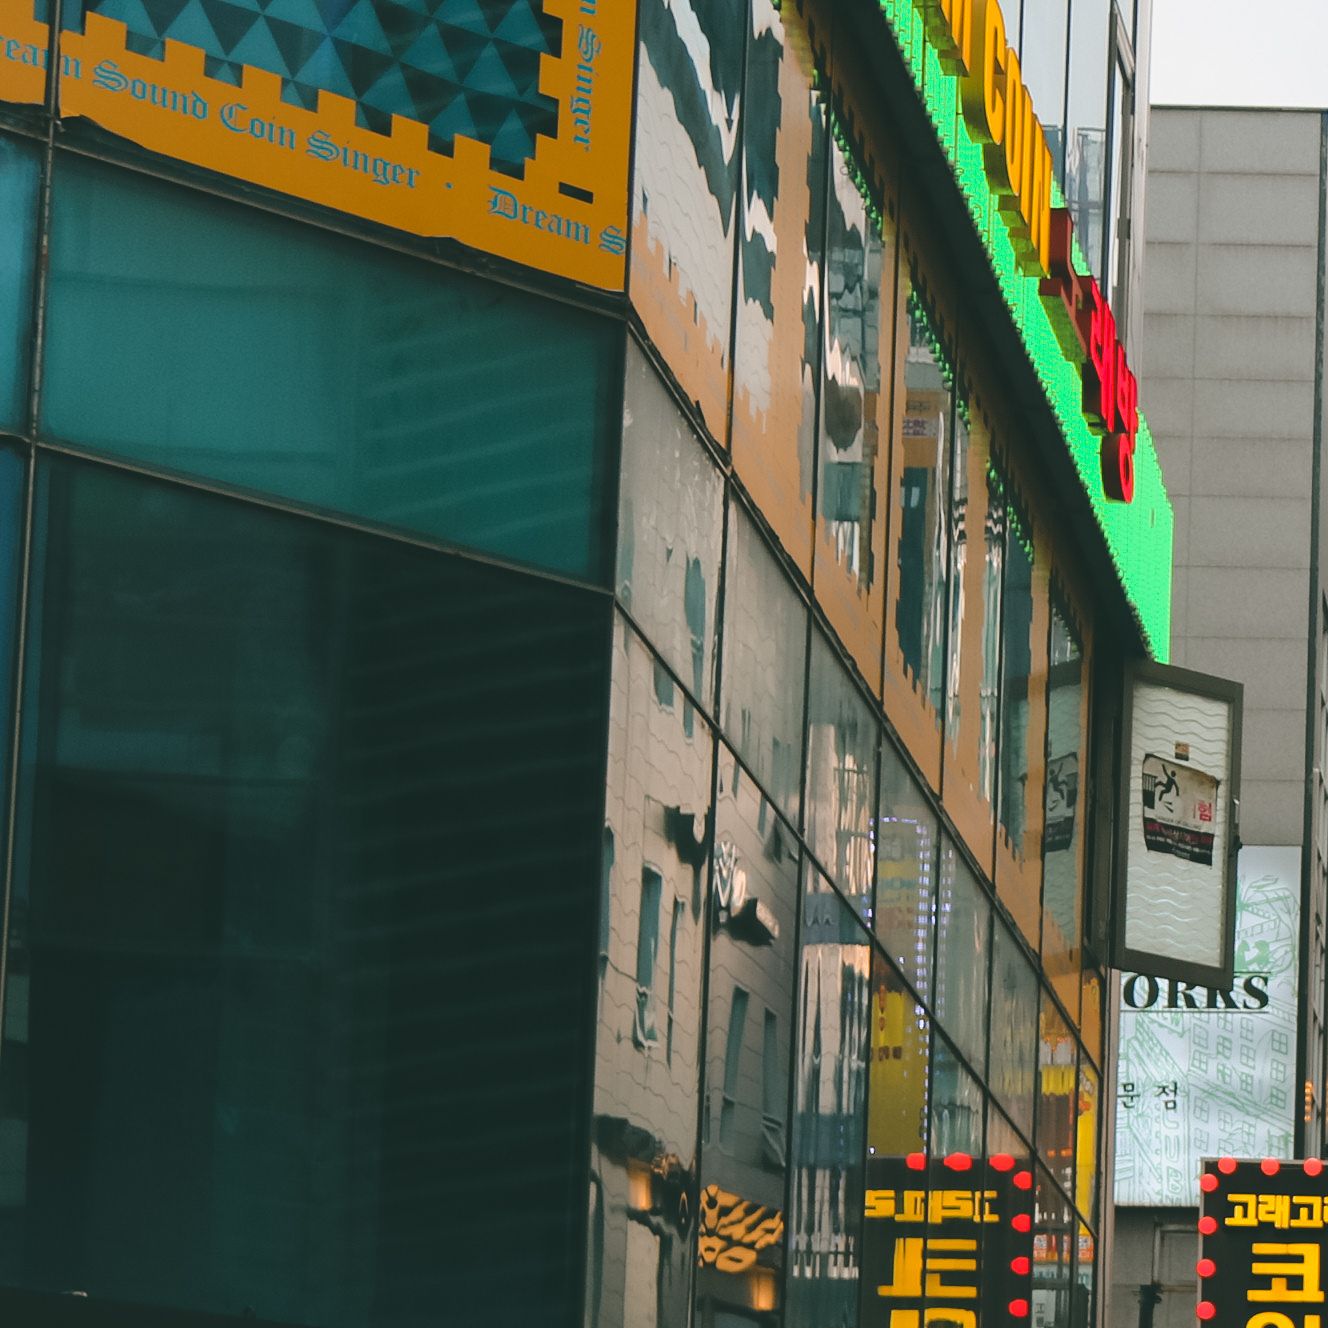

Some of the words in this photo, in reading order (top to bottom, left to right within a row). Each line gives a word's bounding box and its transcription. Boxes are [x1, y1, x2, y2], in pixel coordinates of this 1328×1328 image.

[92, 57, 208, 121] Sound
[218, 103, 297, 152] Coin
[305, 130, 420, 190] Singer
[487, 185, 591, 247] Dream
[572, 22, 601, 153] Singer
